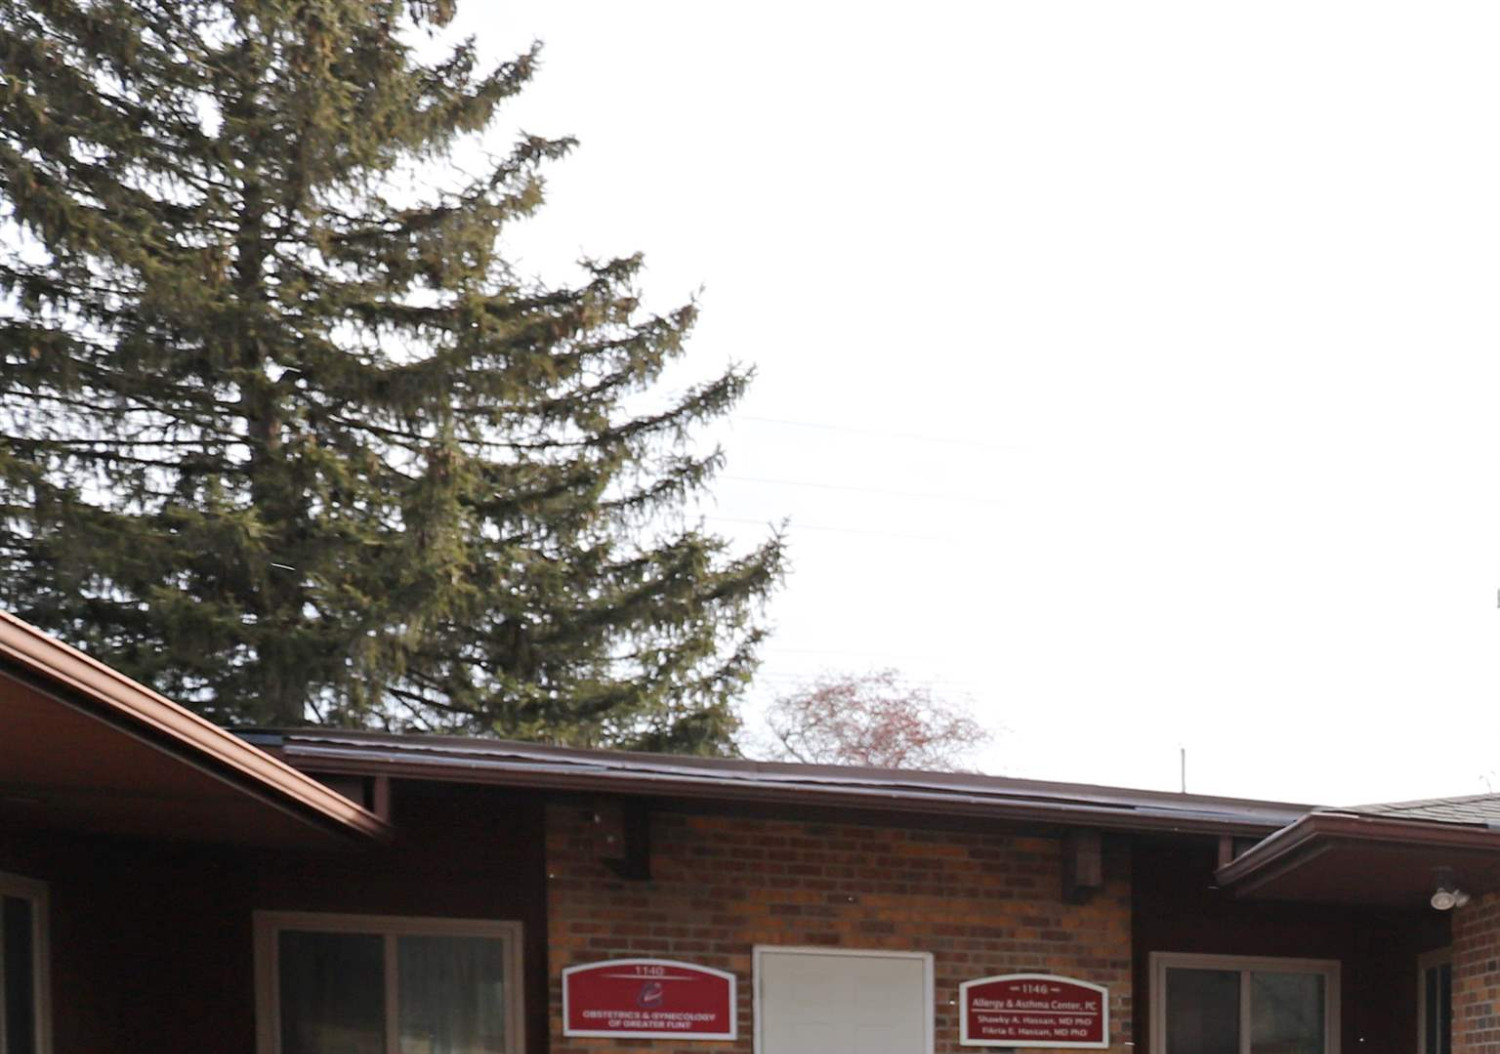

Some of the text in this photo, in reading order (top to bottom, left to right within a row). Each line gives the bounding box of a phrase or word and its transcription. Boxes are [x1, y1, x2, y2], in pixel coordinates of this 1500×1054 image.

[1022, 984, 1049, 995] 1146
[972, 998, 1005, 1009] Allergy
[1006, 999, 1013, 1008] &
[1015, 999, 1050, 1010] Asthma
[1085, 1001, 1097, 1010] PC
[582, 1010, 716, 1021] OBSTETRICS & GYNECOLOGY
[608, 1019, 692, 1029] OF GREATER FLINT
[1058, 1018, 1073, 1026] MD
[1075, 1018, 1092, 1027] PhD
[1054, 1029, 1069, 1037] MD
[1070, 1029, 1088, 1037] PhD
